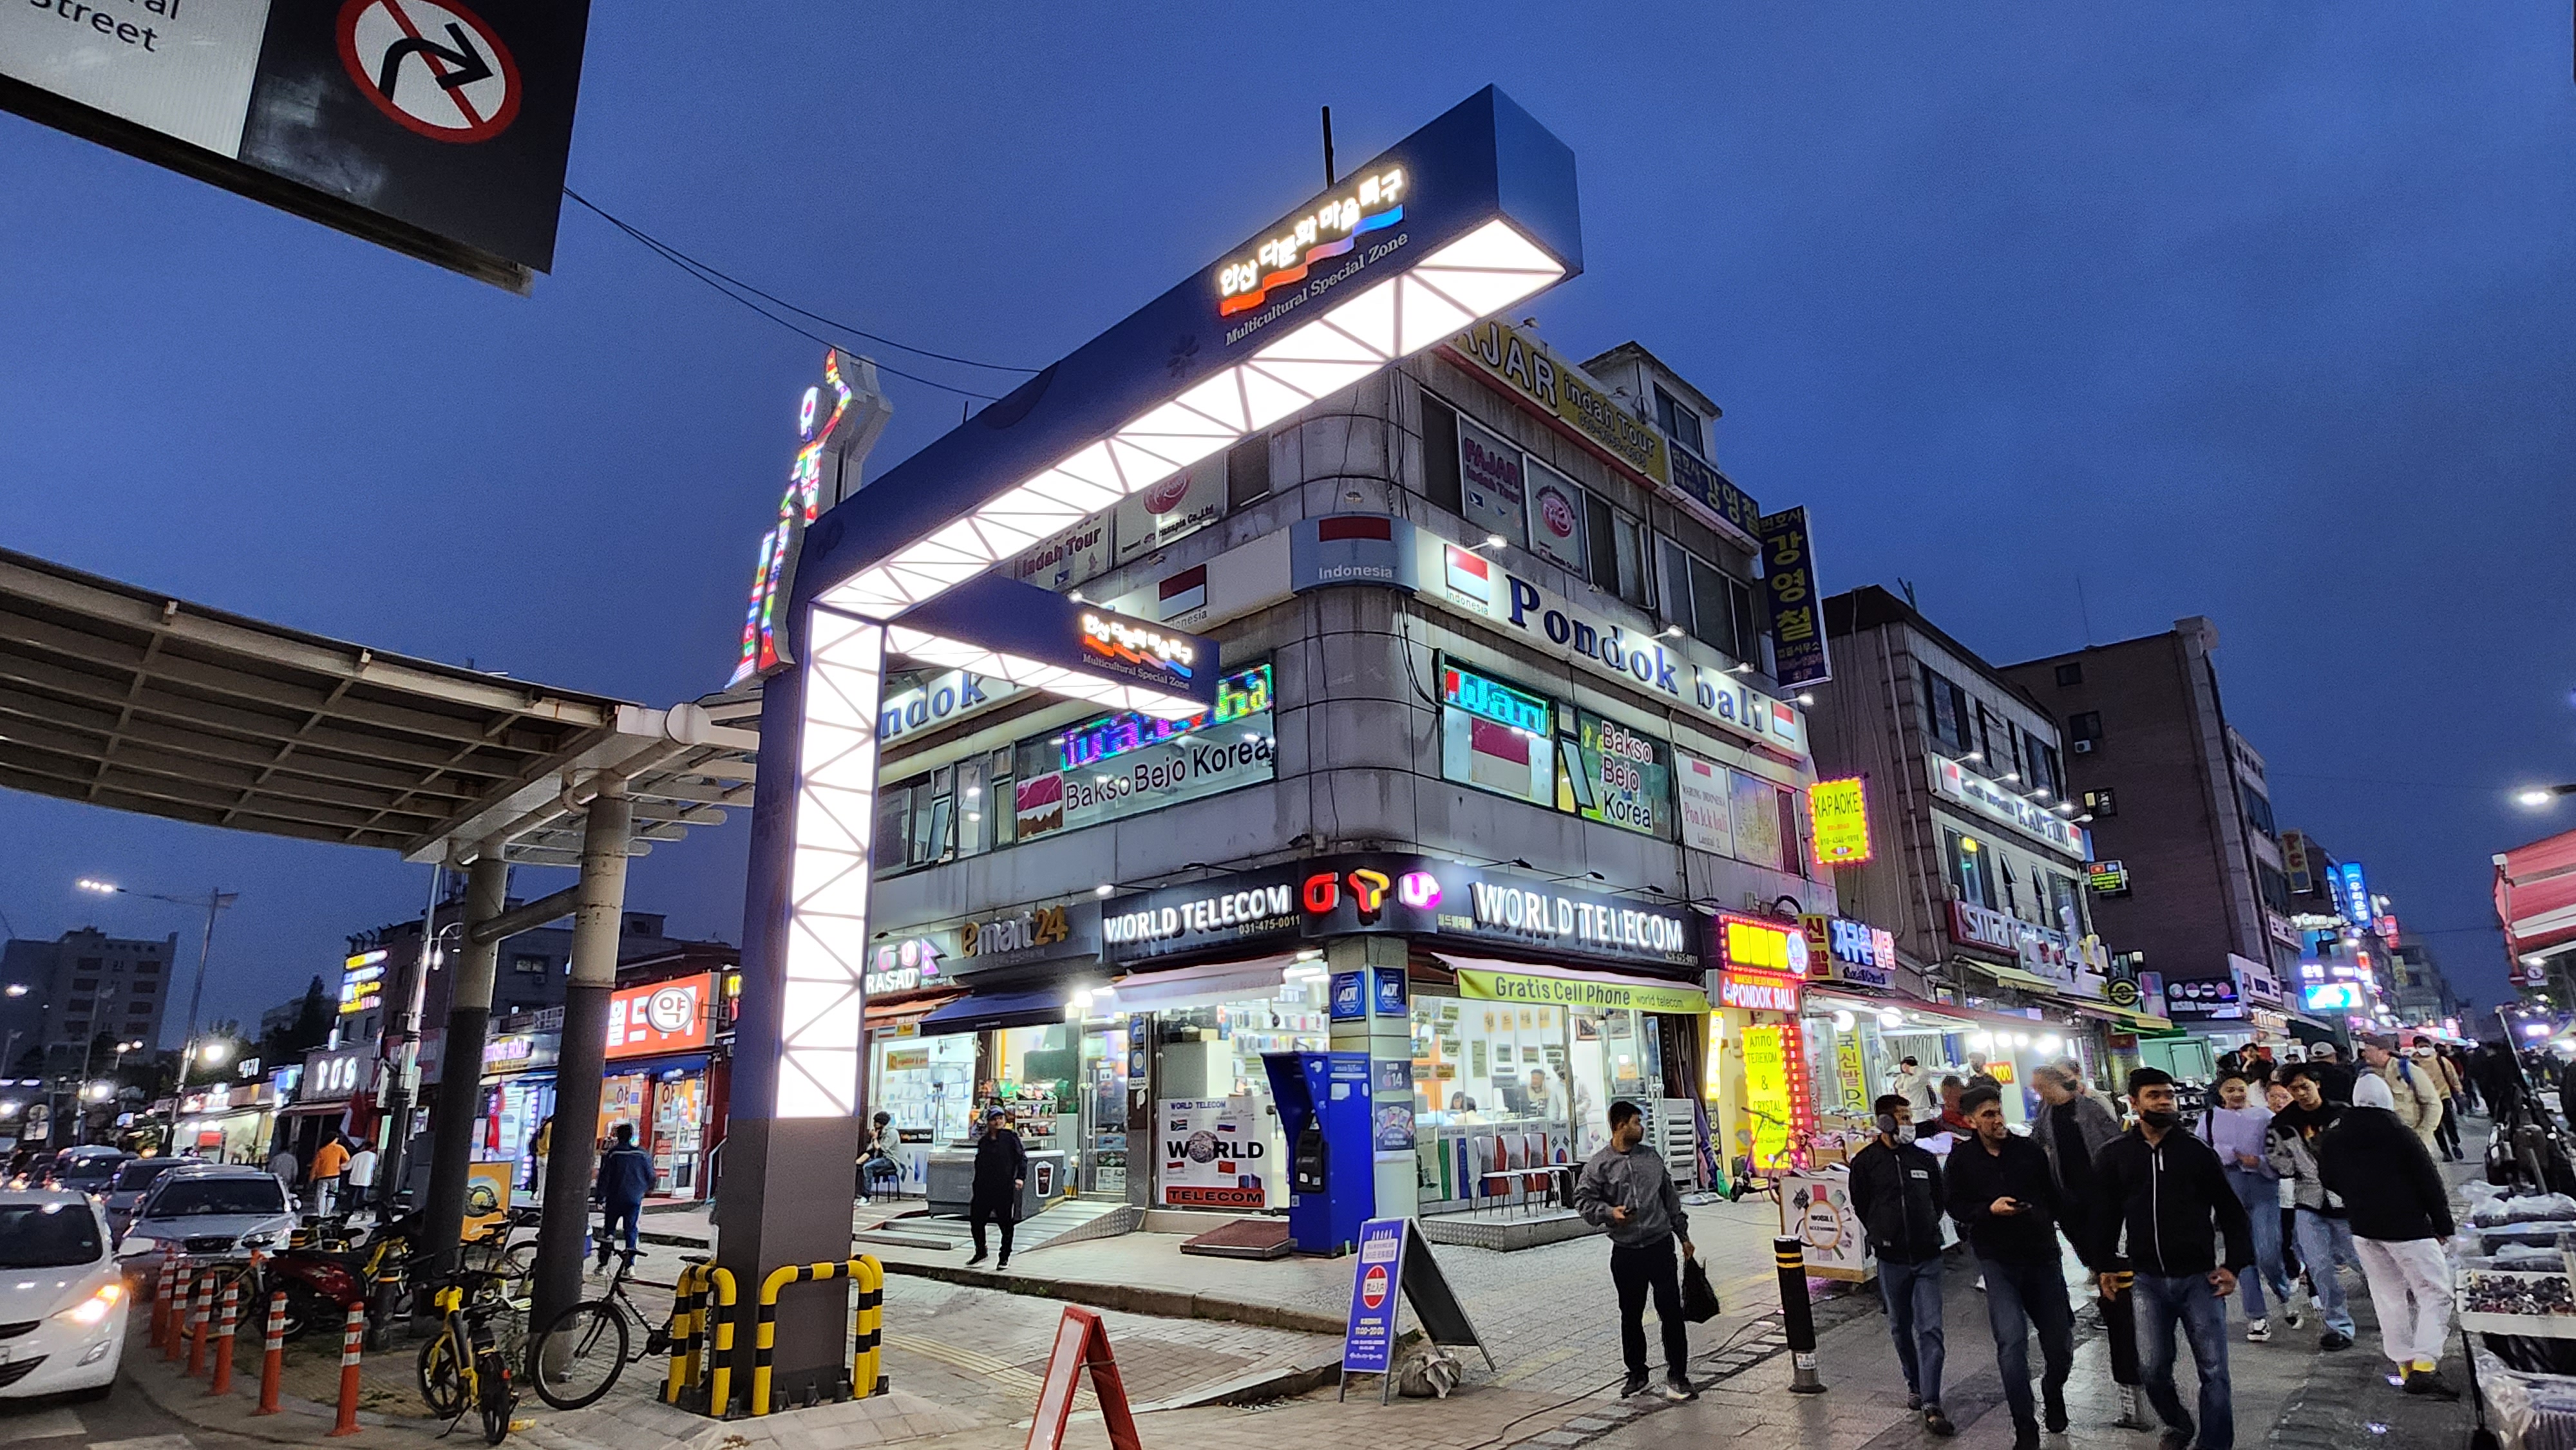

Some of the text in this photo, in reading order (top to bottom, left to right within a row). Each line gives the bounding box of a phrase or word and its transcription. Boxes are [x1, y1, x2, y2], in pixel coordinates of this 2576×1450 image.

[1226, 232, 1409, 346] Multicultural Special Zone
[1464, 321, 1558, 408] JAR
[1616, 411, 1656, 457] Tour
[1464, 437, 1520, 489] FAJAR
[1065, 527, 1101, 556] Tour
[1318, 564, 1393, 579] Indonesia
[1767, 530, 1815, 643] 강영철
[1169, 609, 1208, 629] donesia
[1446, 588, 1489, 616] Indonesia
[1505, 574, 1765, 733] Pondok bali
[1083, 653, 1190, 690] Multicultural Special Zone
[881, 671, 987, 739] ndok
[1601, 719, 1654, 766] Bakso
[1066, 776, 1132, 811] Bakso
[1134, 757, 1186, 793] Bejo
[1193, 737, 1271, 778] Korea
[1602, 756, 1641, 793] Bejo
[1603, 789, 1653, 829] Korea
[1103, 884, 1293, 943] WORLD TELECOM
[1238, 914, 1301, 935] 031-475-0011
[1472, 881, 1685, 952] WORLD TELECOM
[1804, 917, 1830, 976] 신발
[866, 967, 920, 995] RASAD
[1338, 986, 1358, 1003] ADT
[1381, 983, 1399, 997] ADT
[1495, 975, 1685, 1009] Gratis Cell Phone world telecom
[1732, 983, 1795, 1011] PONDOK BALI
[659, 997, 687, 1023] 약
[1391, 1072, 1403, 1088] 14
[1761, 1075, 1769, 1091] &
[1170, 1100, 1226, 1110] WORLD TELECOM
[1168, 1191, 1262, 1203] TELECOM
[1810, 1214, 1834, 1223] MOBILE
